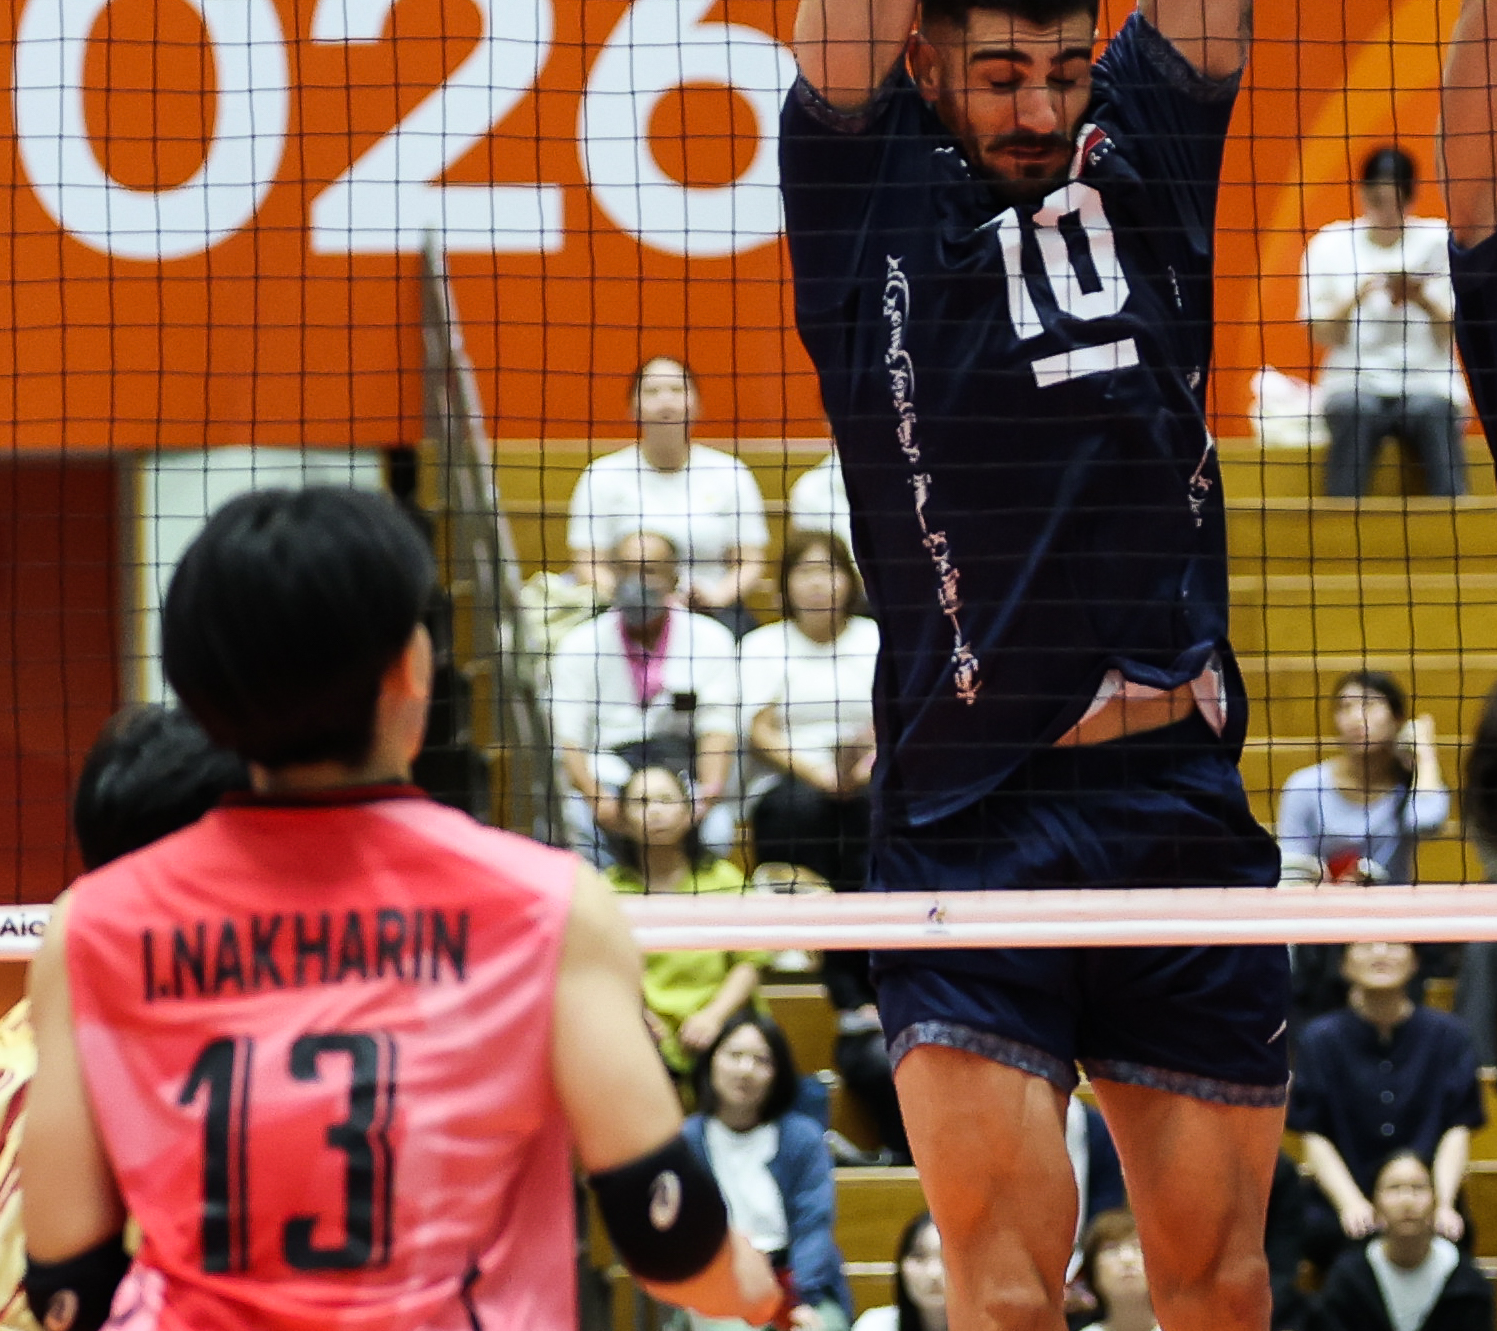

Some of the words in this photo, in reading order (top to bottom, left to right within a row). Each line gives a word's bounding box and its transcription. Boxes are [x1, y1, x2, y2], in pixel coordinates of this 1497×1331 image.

[996, 181, 1133, 341] 10
[0, 913, 52, 938] Aic
[141, 906, 473, 1003] I.NAKHARIN
[177, 1029, 398, 1273] 13
